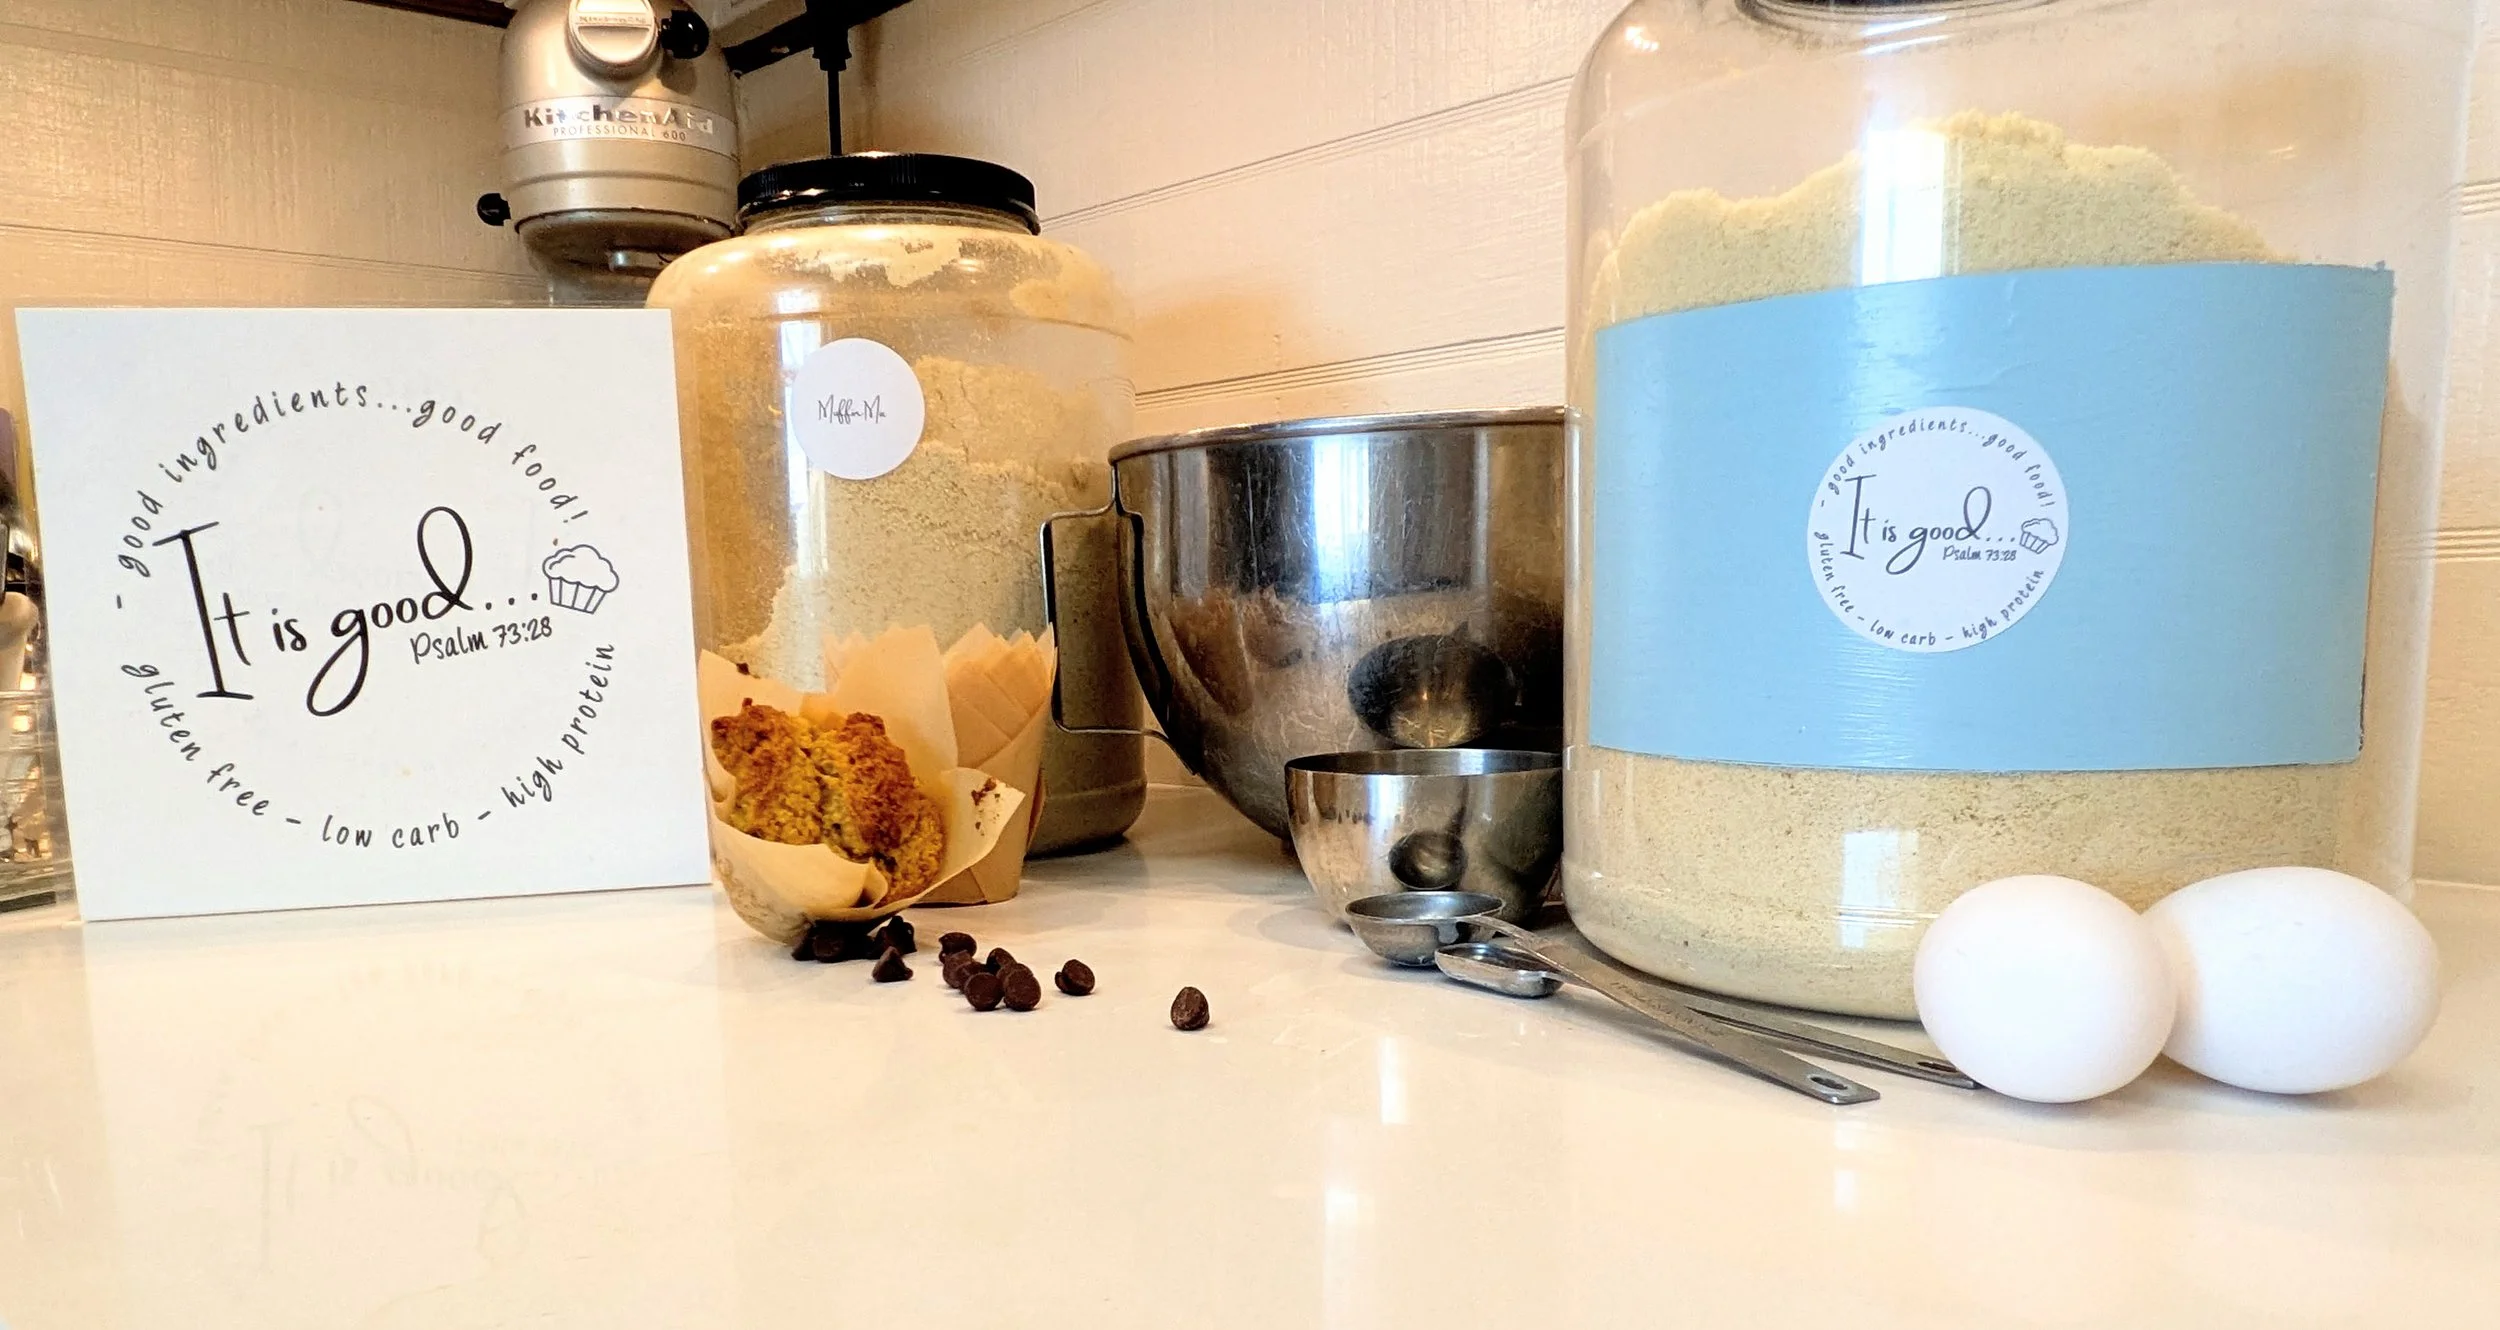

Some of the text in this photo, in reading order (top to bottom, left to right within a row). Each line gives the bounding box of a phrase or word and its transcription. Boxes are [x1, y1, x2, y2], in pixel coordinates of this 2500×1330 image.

[523, 103, 714, 134] KitchenAid
[553, 123, 686, 142] PROFESSIONAL 600
[118, 490, 164, 578] good
[512, 444, 588, 523] food!
[1828, 454, 1855, 495] good
[2024, 464, 2056, 508] food!
[1840, 474, 1877, 560] It
[1882, 519, 1898, 543] is
[1813, 531, 1834, 582] gluten
[1831, 585, 1855, 614] free
[1870, 619, 1895, 639] low
[1901, 632, 1936, 646] carb
[1962, 616, 1997, 640] high
[2000, 570, 2044, 621] protein
[1942, 545, 2017, 562] Psalm 73:28
[152, 521, 254, 700] It
[272, 608, 307, 652] is
[410, 616, 552, 665] Psalm 73:28
[121, 664, 201, 761] gluten
[207, 763, 269, 816] free
[322, 814, 372, 848] low
[392, 812, 459, 848] carb
[501, 756, 563, 808] high
[561, 644, 615, 755] protein
